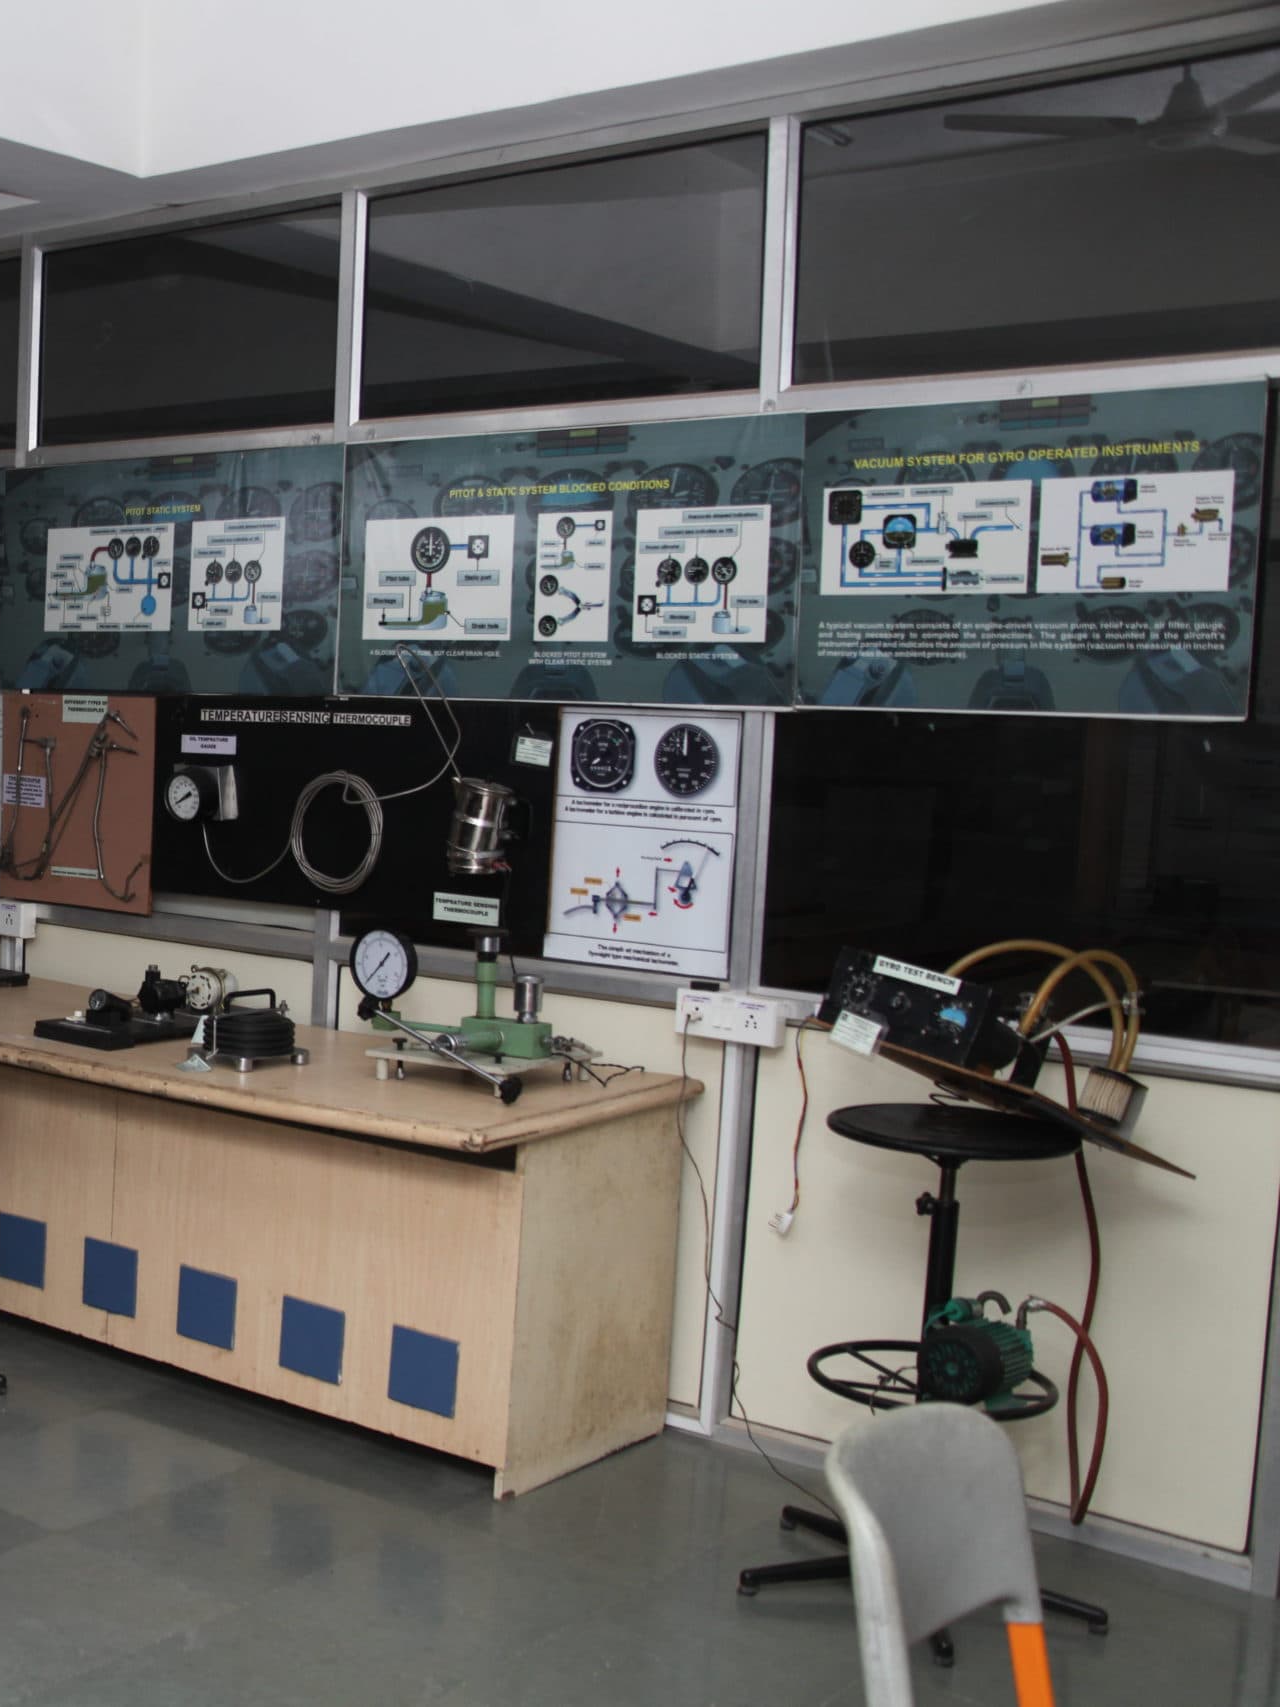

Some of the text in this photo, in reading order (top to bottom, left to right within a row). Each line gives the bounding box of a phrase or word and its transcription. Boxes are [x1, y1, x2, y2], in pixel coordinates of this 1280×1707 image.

[853, 440, 1200, 470] VACUUM SYSTEM FOR GYRO OPERATED INSTRUMENTS
[449, 479, 670, 499] PITOT & STATIC SYSTEM BLOCKED CONDITIONS
[125, 503, 201, 516] PITOT STATIC SYSTEM
[1040, 632, 1056, 640] The
[1163, 632, 1178, 640] the
[202, 710, 411, 726] TEMPERATURE SENSING THERMOCOUPLE
[879, 960, 956, 987] GYRO TEST BENCH
